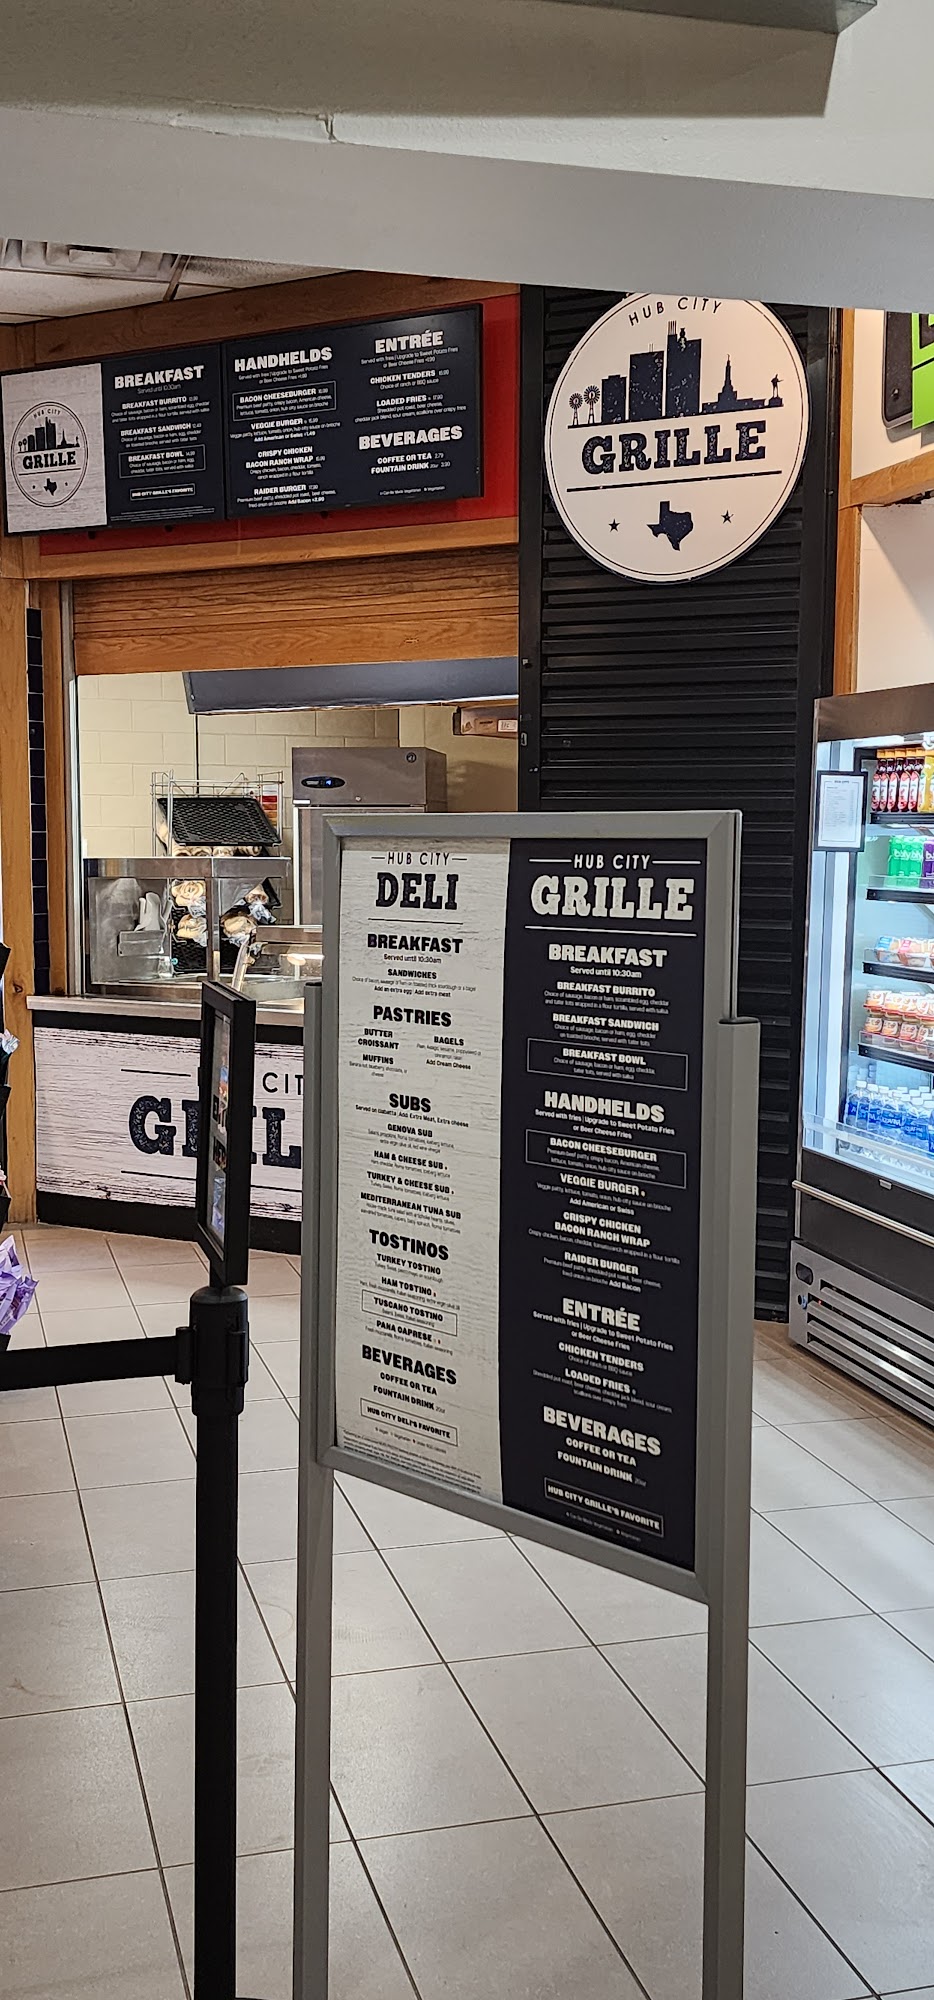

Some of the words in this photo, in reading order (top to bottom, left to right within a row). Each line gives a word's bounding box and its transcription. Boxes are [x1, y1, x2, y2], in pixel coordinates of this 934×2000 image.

[629, 302, 664, 326] HUB
[678, 297, 721, 314] CITY
[375, 329, 444, 354] ENTRÉE
[234, 347, 332, 372] HANDHELDS
[114, 365, 204, 390] BREAKFAST
[370, 374, 401, 384] CHICKEN
[402, 370, 435, 380] TENDERS
[122, 399, 158, 410] BREAKFAST
[159, 396, 187, 405] BURRITO
[240, 394, 262, 403] BACON
[264, 388, 316, 401] CHEESEBURGER
[376, 397, 404, 407] LOADED
[406, 395, 427, 404] FRIES
[120, 426, 156, 436] BREAKFAST
[157, 423, 191, 433] SANDWICH
[251, 421, 275, 430] VEGGIE
[276, 418, 303, 427] BURGER
[359, 425, 463, 450] BEVERAGES
[581, 420, 766, 475] GRILLE
[22, 451, 76, 469] GRILLE
[128, 452, 165, 462] BREAKFAST
[166, 450, 184, 459] BOWL
[246, 460, 268, 469] BACON
[269, 457, 292, 466] RANCH
[293, 455, 313, 464] WRAP
[258, 449, 282, 458] CRISPY
[284, 446, 312, 455] CHICKEN
[377, 455, 405, 464] COFFEE
[406, 454, 416, 462] OR
[417, 452, 432, 461] TEA
[371, 464, 406, 474] FOUNTAIN
[407, 462, 429, 471] DRINK
[254, 487, 278, 495] RAIDER
[279, 484, 306, 493] BURGER
[388, 852, 412, 864] HUB
[420, 852, 450, 865] CITY
[574, 854, 604, 868] HUB
[613, 855, 650, 869] CITY
[376, 872, 458, 910] DELI
[531, 875, 694, 920] GRILLE
[367, 934, 463, 953] BREAKFAST
[549, 944, 667, 967] BREAKFAST
[388, 969, 437, 979] SANDWICHES
[570, 966, 594, 975] Served
[595, 968, 611, 976] until
[612, 969, 642, 978] 10:30am
[557, 981, 611, 994] BREAKFAST
[613, 985, 655, 997] BURRITO
[373, 1005, 451, 1027] PASTRIES
[553, 1013, 606, 1026] BREAKFAST
[608, 1018, 659, 1031] SANDWICH
[358, 1039, 399, 1049] CROISSANT
[364, 1028, 393, 1038] BUTTER
[434, 1036, 464, 1046] BAGELS
[363, 1054, 394, 1065] MUFFINS
[437, 1060, 452, 1068] Cream
[453, 1062, 471, 1070] Cheese
[562, 1048, 617, 1062] BREAKFAST
[619, 1054, 646, 1065] BOWL
[262, 1072, 304, 1096] CIT
[389, 1093, 431, 1113] SUBS
[544, 1091, 664, 1123] HANDHELDS
[388, 1124, 416, 1135] GENOVA
[418, 1128, 432, 1137] SUB
[535, 1109, 555, 1118] Served
[556, 1112, 568, 1120] with
[569, 1113, 581, 1122] fries
[585, 1116, 609, 1126] Upgrade
[610, 1119, 617, 1127] to
[618, 1120, 636, 1130] Sweet
[637, 1123, 658, 1133] Potato
[659, 1126, 675, 1135] Fries
[580, 1125, 593, 1133] Beer
[595, 1127, 616, 1137] Cheese
[617, 1130, 632, 1139] Fries
[374, 1151, 390, 1160] HAM
[398, 1155, 426, 1167] CHEESE
[428, 1160, 444, 1170] SUB
[550, 1138, 581, 1150] BACON
[582, 1142, 657, 1162] CHEESEBURGER
[367, 1171, 395, 1184] TURKEY
[397, 1176, 402, 1185] &
[404, 1178, 433, 1190] CHEESE
[434, 1183, 450, 1194] SUB
[560, 1173, 596, 1188] VEGGIE
[598, 1179, 639, 1195] BURGER
[361, 1192, 422, 1211] MEDITERRANEAN
[423, 1204, 444, 1216] TUNA
[445, 1209, 461, 1219] SUB
[563, 1211, 598, 1226] CRISPY
[599, 1218, 641, 1234] CHICKEN
[369, 1229, 449, 1261] TOSTINOS
[554, 1222, 586, 1236] BACON
[587, 1228, 619, 1242] RANCH
[621, 1234, 650, 1248] WRAP
[377, 1253, 406, 1267] TURKEY
[407, 1260, 441, 1275] TOSTINO
[564, 1252, 599, 1267] RAIDER
[600, 1259, 639, 1275] BURGER
[381, 1277, 397, 1287] HAM
[399, 1281, 432, 1296] TOSTINO
[609, 1280, 621, 1289] Add
[622, 1282, 641, 1292] Bacon
[374, 1297, 409, 1313] TUSCANO
[410, 1306, 443, 1322] TOSTINO
[563, 1298, 641, 1332] ENTRÉE
[376, 1320, 396, 1332] PANA
[397, 1325, 432, 1342] CAPRESE
[533, 1311, 552, 1322] Served
[554, 1316, 566, 1325] with
[567, 1319, 579, 1329] fries
[583, 1323, 607, 1335] Upgrade
[609, 1329, 615, 1337] to
[616, 1331, 634, 1342] Sweet
[636, 1335, 657, 1347] Potato
[658, 1341, 674, 1352] Fries
[571, 1330, 577, 1338] or
[579, 1332, 592, 1342] Beer
[592, 1335, 614, 1347] Cheese
[615, 1340, 630, 1351] Fries
[362, 1344, 457, 1384] BEVERAGES
[559, 1342, 598, 1360] CHICKEN
[600, 1351, 644, 1372] TENDERS
[380, 1372, 408, 1387] COFFEE
[410, 1380, 420, 1391] OR
[422, 1383, 437, 1396] TEA
[565, 1368, 601, 1386] LOADED
[603, 1377, 630, 1394] FRIES
[374, 1385, 410, 1403] FOUNTAIN
[411, 1396, 434, 1410] DRINK
[367, 1406, 380, 1417] HUB
[381, 1411, 396, 1422] CITY
[398, 1416, 418, 1428] DELI'S
[419, 1422, 450, 1439] FAVORITE
[543, 1406, 661, 1456] BEVERAGES
[566, 1437, 601, 1456] COFFEE
[602, 1448, 616, 1460] OR
[617, 1452, 636, 1467] TEA
[557, 1451, 602, 1473] FOUNTAIN
[604, 1465, 633, 1482] DRINK
[548, 1485, 564, 1498] HUB
[565, 1490, 583, 1504] CITY
[584, 1497, 619, 1516] GRILLE'S
[621, 1508, 660, 1530] FAVORITE
